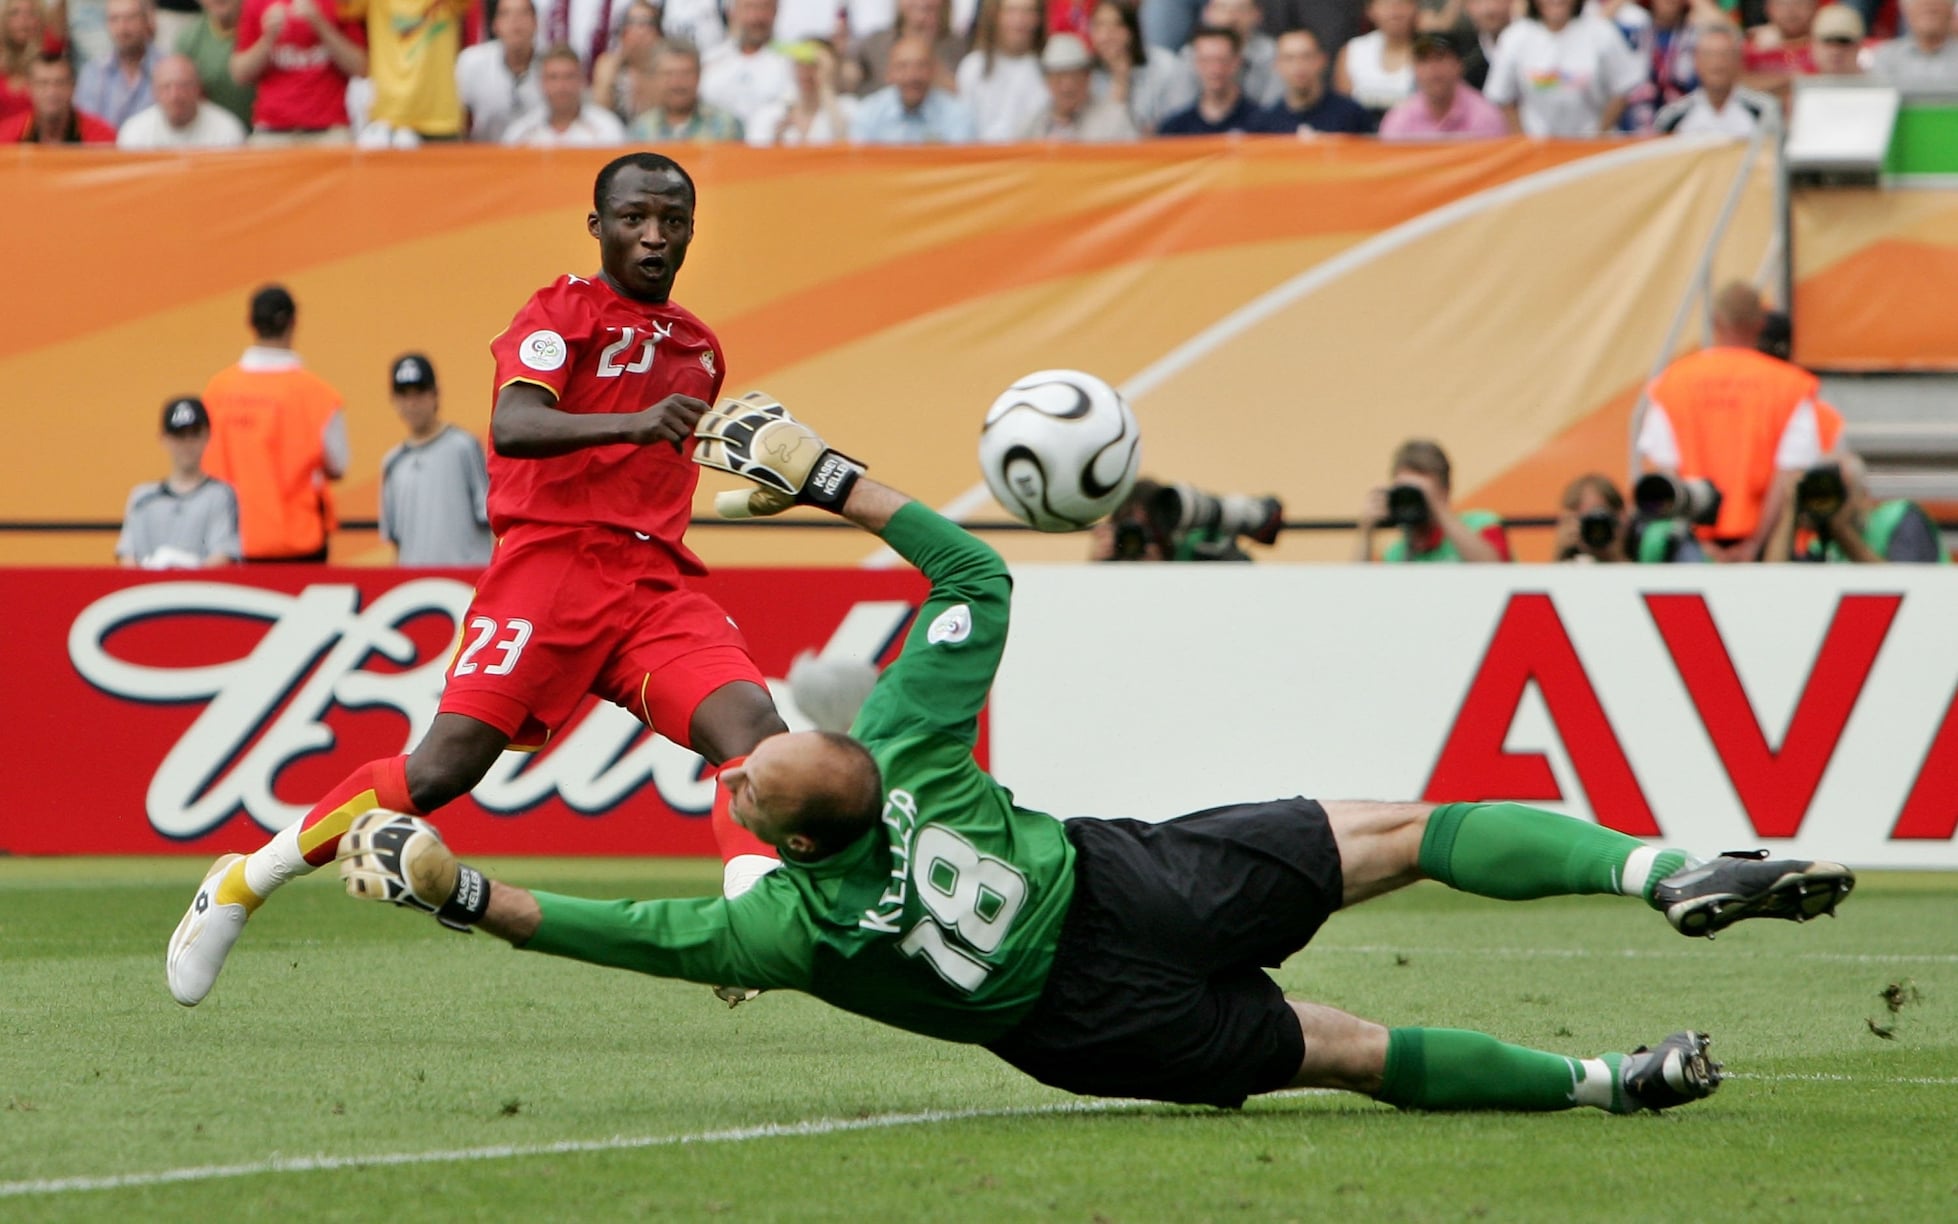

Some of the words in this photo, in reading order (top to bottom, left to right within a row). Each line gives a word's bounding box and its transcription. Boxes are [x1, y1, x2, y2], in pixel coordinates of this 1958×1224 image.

[453, 615, 533, 678] 23
[1420, 592, 1958, 839] AV
[858, 788, 918, 933] KELLER
[895, 821, 1029, 996] 18
